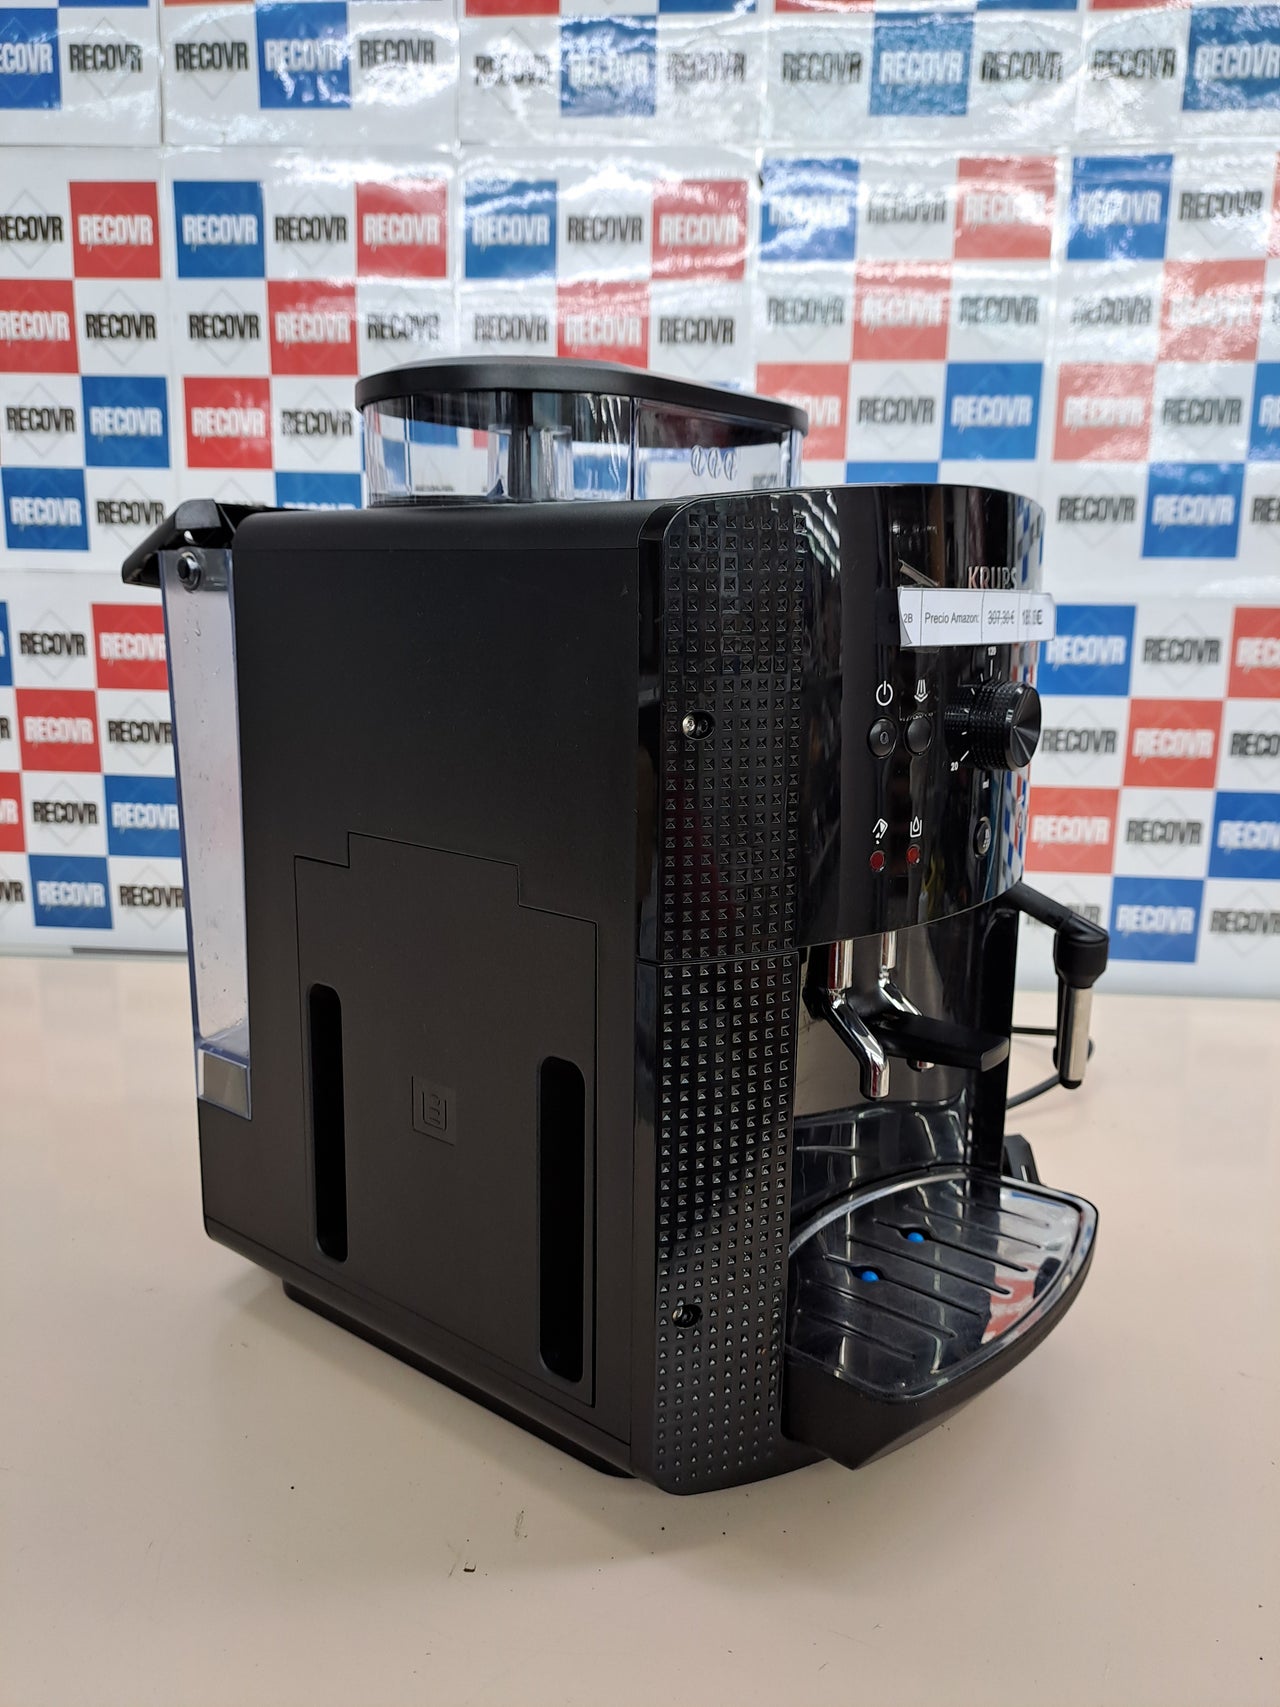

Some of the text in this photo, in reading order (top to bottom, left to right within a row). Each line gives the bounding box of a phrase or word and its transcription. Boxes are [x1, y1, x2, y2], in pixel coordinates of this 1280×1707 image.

[69, 43, 142, 73] RECOVR
[175, 41, 248, 71] RECOVR
[265, 39, 343, 71] RECOVR
[360, 38, 435, 67] RECOVR
[782, 51, 861, 83] RECOVR
[879, 51, 962, 84] RECOVR
[981, 51, 1063, 83] RECOVR
[78, 214, 153, 245] RECOVR
[182, 214, 258, 245] RECOVR
[275, 215, 348, 242] RECOVR
[363, 213, 440, 245] RECOVR
[472, 214, 550, 245] RECOVR
[568, 216, 642, 243] RECOVR
[659, 214, 739, 245] RECOVR
[769, 296, 844, 324] RECOVR
[861, 296, 942, 326] RECOVR
[960, 296, 1039, 324] RECOVR
[85, 312, 157, 339] RECOVR
[188, 313, 260, 339] RECOVR
[275, 311, 351, 343] RECOVR
[475, 313, 547, 341] RECOVR
[564, 316, 641, 345] RECOVR
[659, 317, 735, 344] RECOVR
[7, 407, 75, 433] RECOVR
[90, 406, 162, 437] RECOVR
[192, 407, 264, 437] RECOVR
[282, 409, 353, 436] RECOVR
[858, 397, 934, 424] RECOVR
[951, 396, 1032, 426] RECOVR
[1064, 396, 1143, 427] RECOVR
[1163, 397, 1242, 424] RECOVR
[11, 496, 82, 526] RECOVR
[98, 500, 164, 525] RECOVR
[1057, 496, 1136, 523] RECOVR
[1153, 495, 1234, 526] RECOVR
[968, 566, 1017, 589] KRUPS
[925, 612, 950, 624] Precio
[19, 632, 86, 656] RECOVR
[1045, 635, 1126, 666] RECOVR
[1143, 637, 1222, 665] RECOVR
[23, 715, 94, 744] RECOVR
[108, 720, 172, 744] RECOVR
[1041, 727, 1117, 755] RECOVR
[1133, 727, 1214, 759] RECOVR
[951, 761, 959, 771] 20
[33, 801, 99, 825] RECOVR
[112, 802, 179, 830] RECOVR
[1032, 815, 1110, 846] RECOVR
[1126, 818, 1203, 846] RECOVR
[36, 880, 105, 908] RECOVR
[120, 885, 184, 908] RECOVR
[1115, 905, 1195, 936] RECOVR
